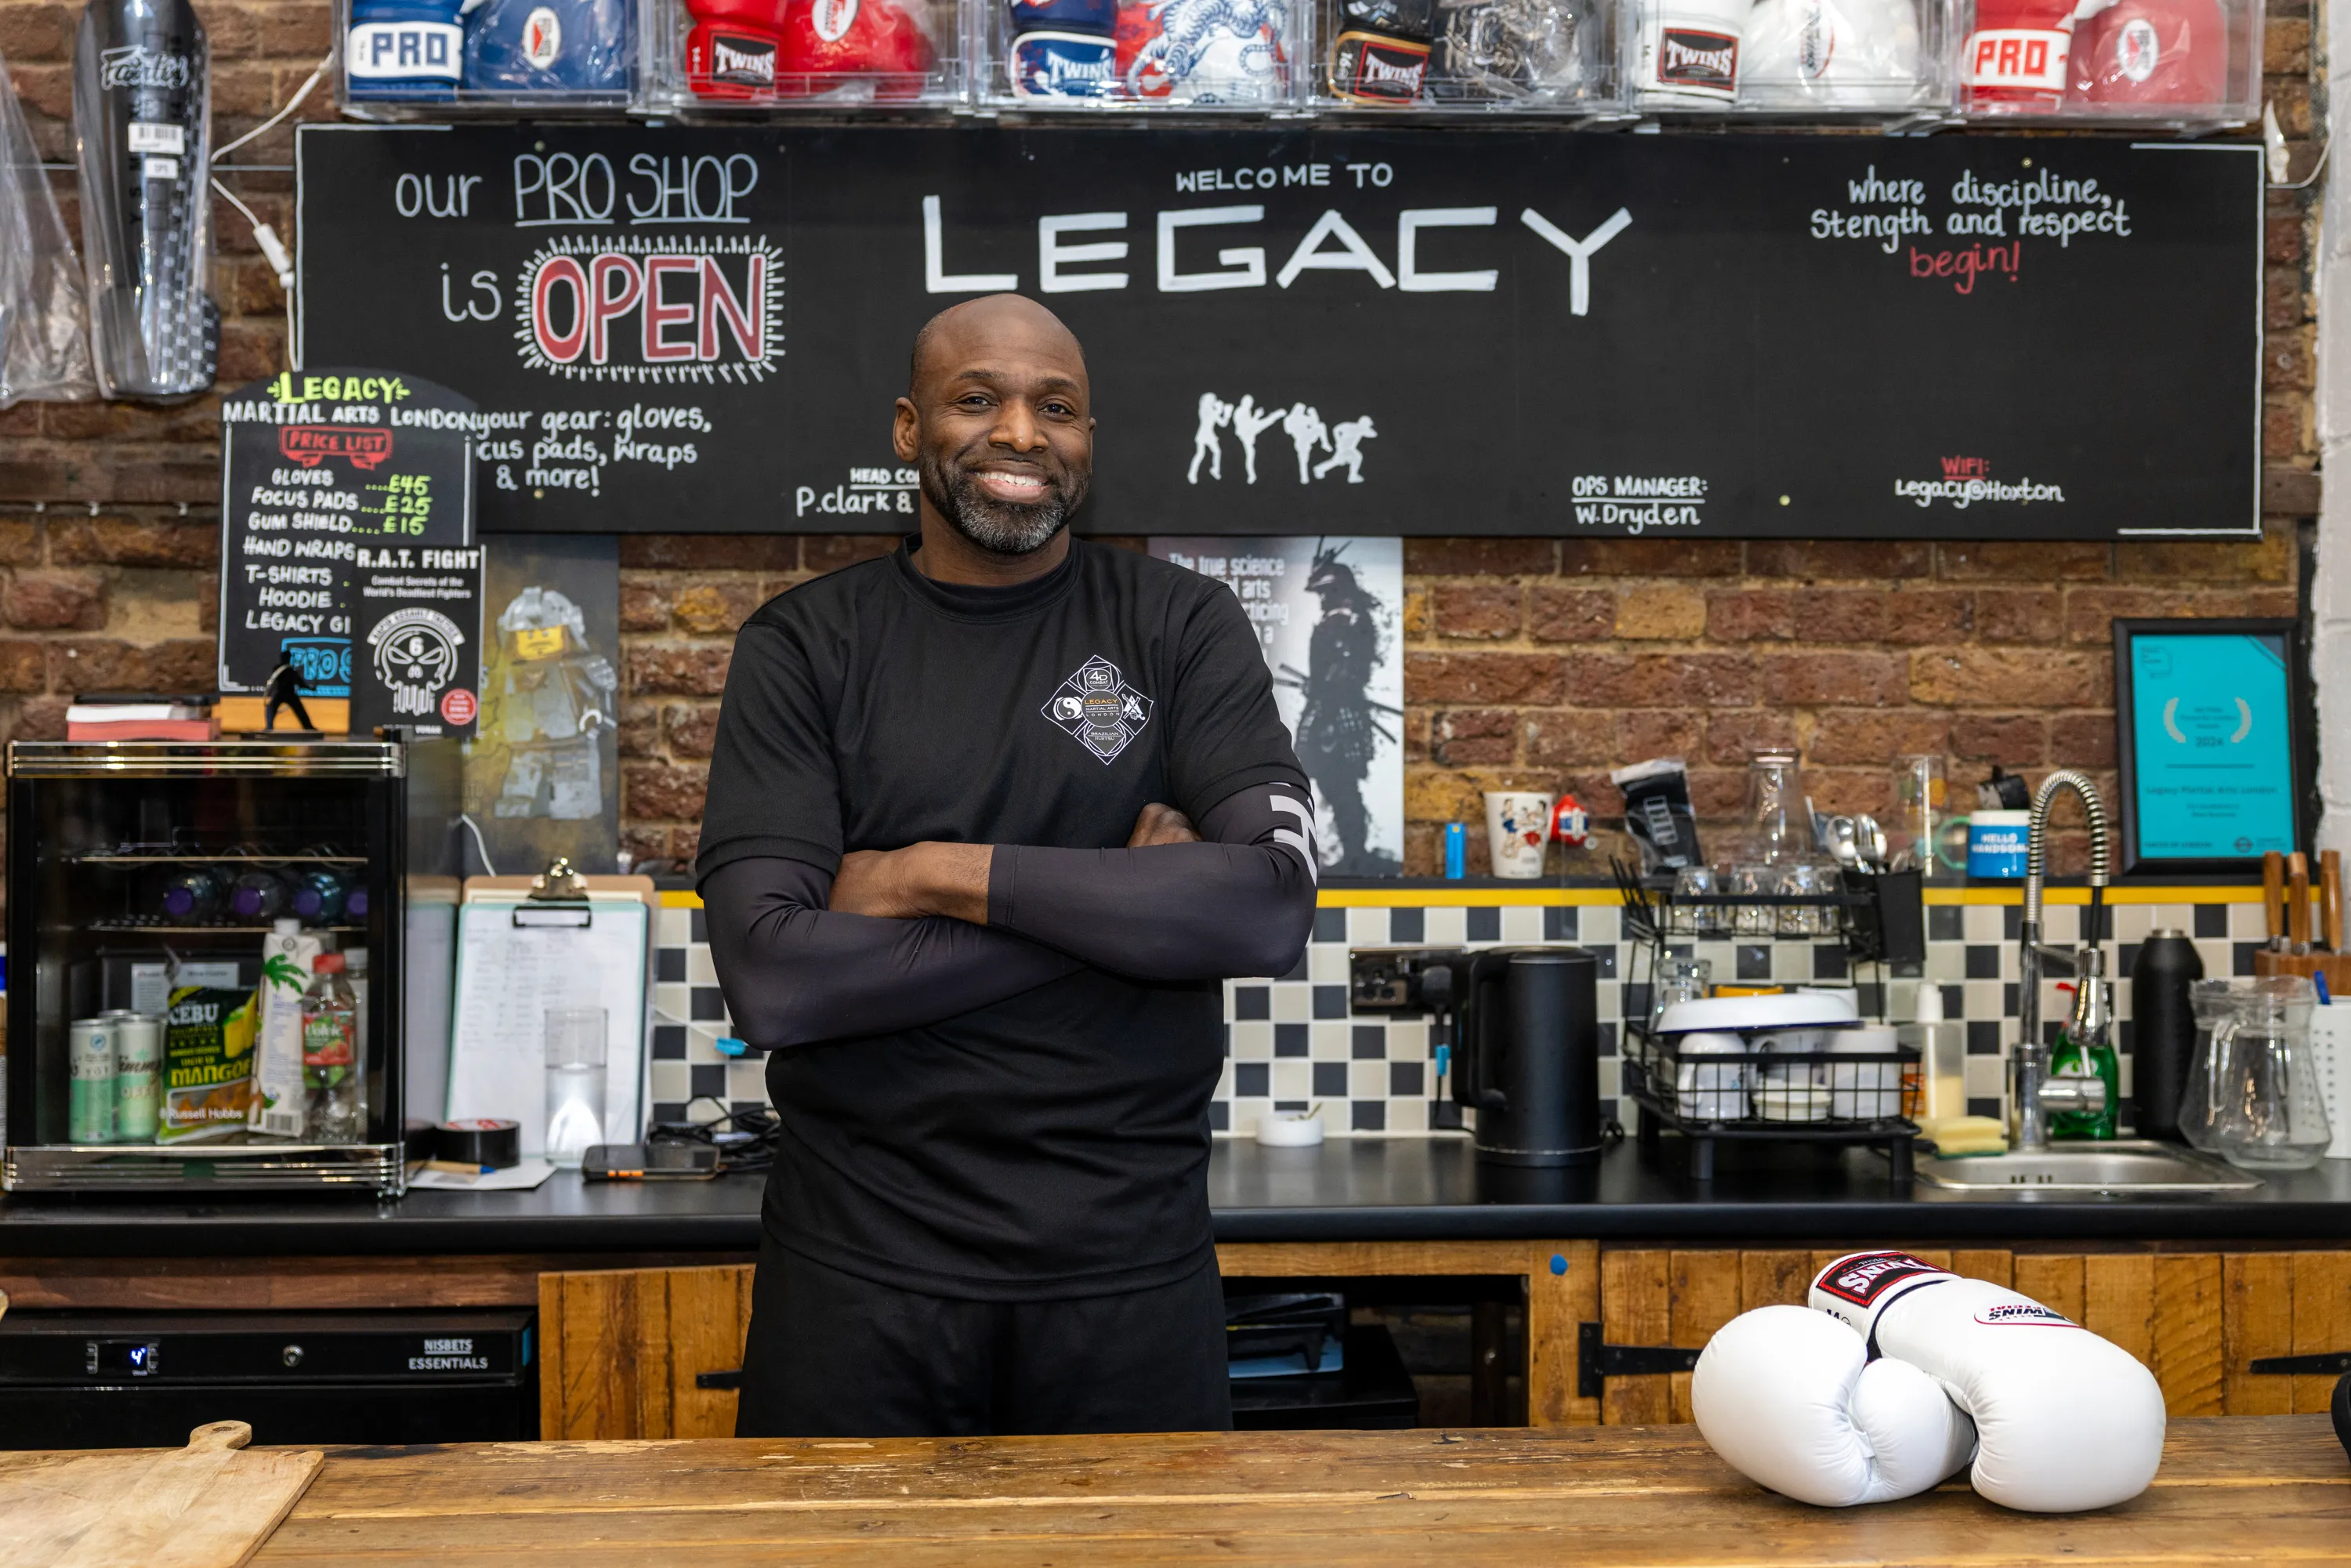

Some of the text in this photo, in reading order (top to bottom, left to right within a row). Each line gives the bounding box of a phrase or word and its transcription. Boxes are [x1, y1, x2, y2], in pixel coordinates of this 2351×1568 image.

[371, 32, 448, 67] PRO
[715, 42, 775, 81] TWINS
[1666, 39, 1733, 77] TWINS
[1046, 48, 1114, 85] TWINS
[1365, 52, 1425, 92] TWINS
[395, 153, 759, 220] our PRO SHOP
[1176, 163, 1393, 193] WELCOME TO
[1848, 165, 2112, 209] where discipline,
[1947, 209, 2006, 237] and
[2019, 201, 2132, 247] respect
[923, 195, 1632, 316] LEGACY
[1910, 240, 2020, 295] begin!
[442, 252, 767, 366] is OPEN
[277, 371, 400, 404] LEGACY
[222, 400, 326, 424] MARTIAL
[331, 406, 380, 424] ARTS
[476, 403, 712, 444] your gear: gloves,
[289, 430, 385, 451] PRICE LIST
[476, 439, 524, 461] cus
[533, 434, 607, 469] pads,
[272, 469, 334, 487] GLOVES
[496, 464, 600, 497] & more!
[849, 466, 892, 484] HEAD
[1572, 475, 1708, 497] OPS MANAGER:
[252, 487, 309, 509] FOCUS
[313, 491, 359, 511] PADS
[897, 491, 915, 513] &
[1895, 478, 2065, 509] Legacy@Hoxton
[248, 511, 288, 531] GUM
[292, 513, 353, 534] SHIELD
[243, 536, 356, 561] HAND WRAPS
[357, 549, 480, 570] R.A.T. FIGHT
[245, 564, 332, 586] T-SHIRTS
[1198, 555, 1227, 577] true
[1230, 554, 1285, 577] science
[363, 586, 472, 600] World's Deadliest Fighters
[371, 575, 464, 587] Combat Secrets of the
[1241, 578, 1271, 599] arts
[259, 587, 332, 609] HOODIE
[245, 610, 324, 634] LEGACY
[409, 636, 424, 657] 6
[1089, 670, 1108, 681] 4D
[2196, 736, 2224, 748] 2024
[1981, 832, 2018, 843] HELLO
[168, 1002, 220, 1026] CEBU
[168, 1106, 244, 1120] Russell Hobbs
[425, 1338, 473, 1352] NISBETS
[408, 1357, 488, 1371] ESSENTIALS
